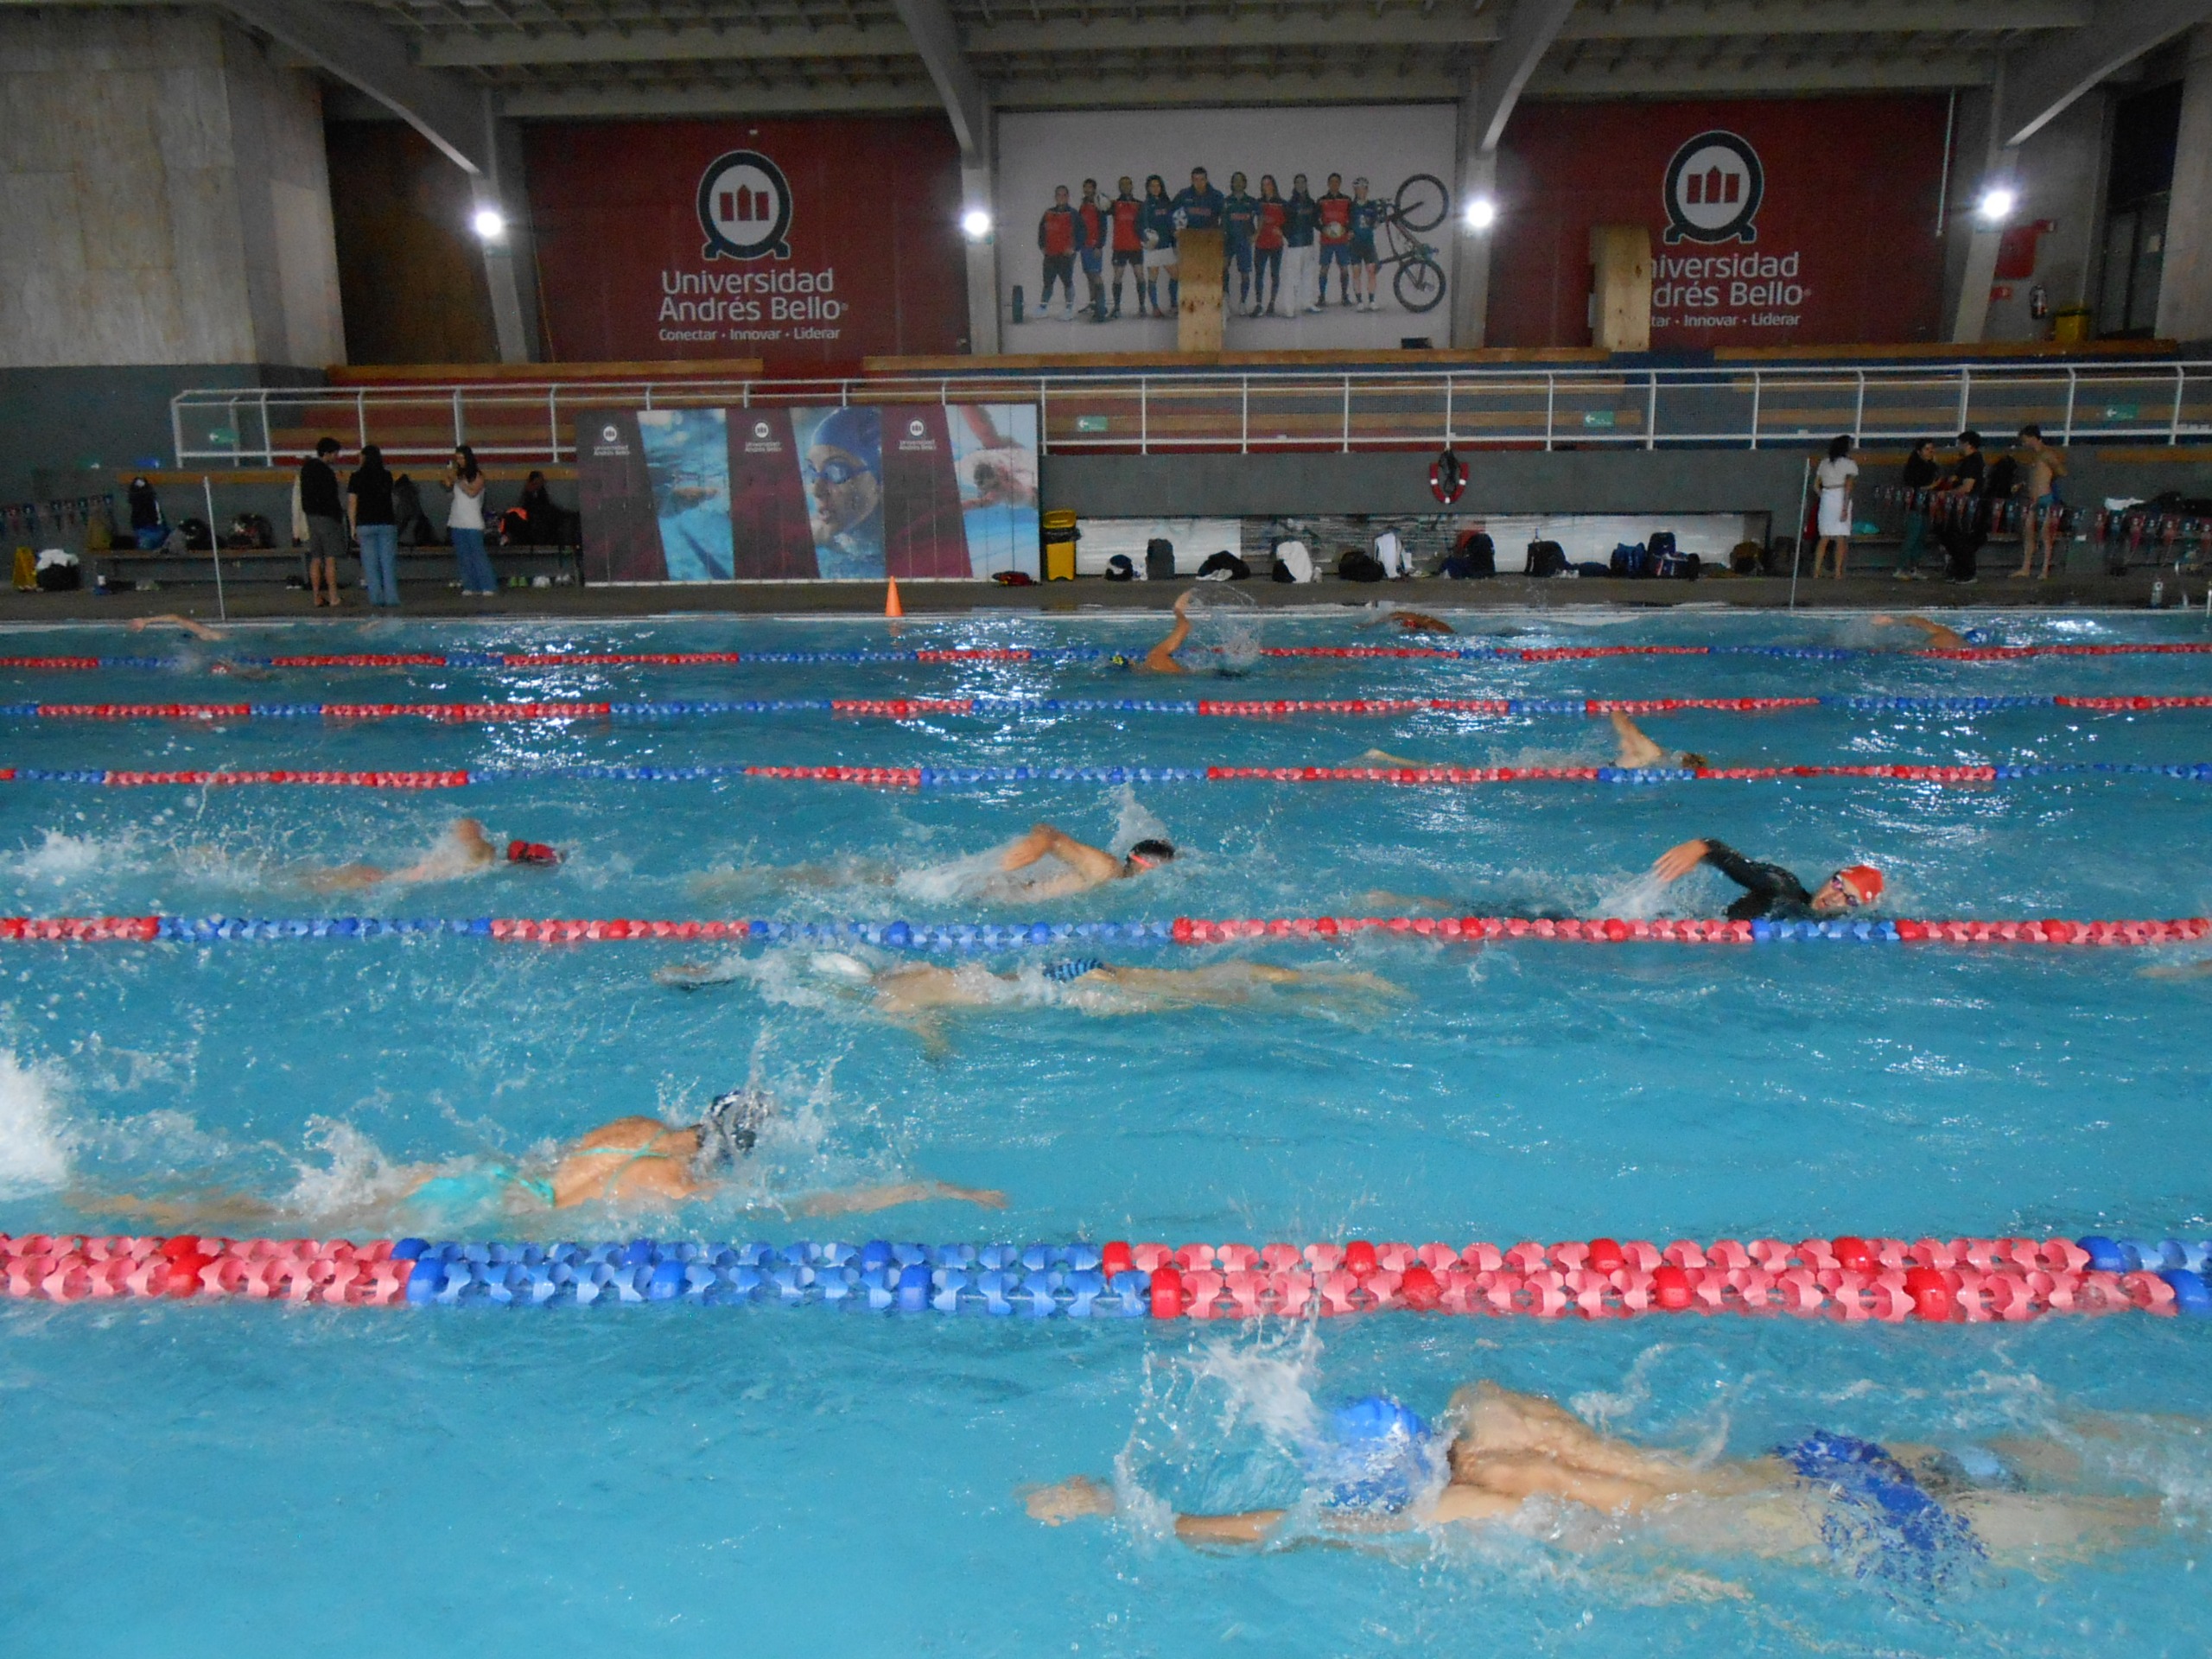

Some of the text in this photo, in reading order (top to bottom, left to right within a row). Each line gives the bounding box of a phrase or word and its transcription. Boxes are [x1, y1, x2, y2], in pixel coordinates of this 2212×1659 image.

[1651, 251, 1799, 278] iversidad
[662, 268, 834, 295] Universidad
[1651, 280, 1804, 307] drés Bello
[658, 296, 842, 321] Andrés Bello
[1684, 314, 1738, 327] Innovar
[1751, 312, 1801, 326] Liderar
[659, 327, 841, 341] Conectar Innovar Liderar
